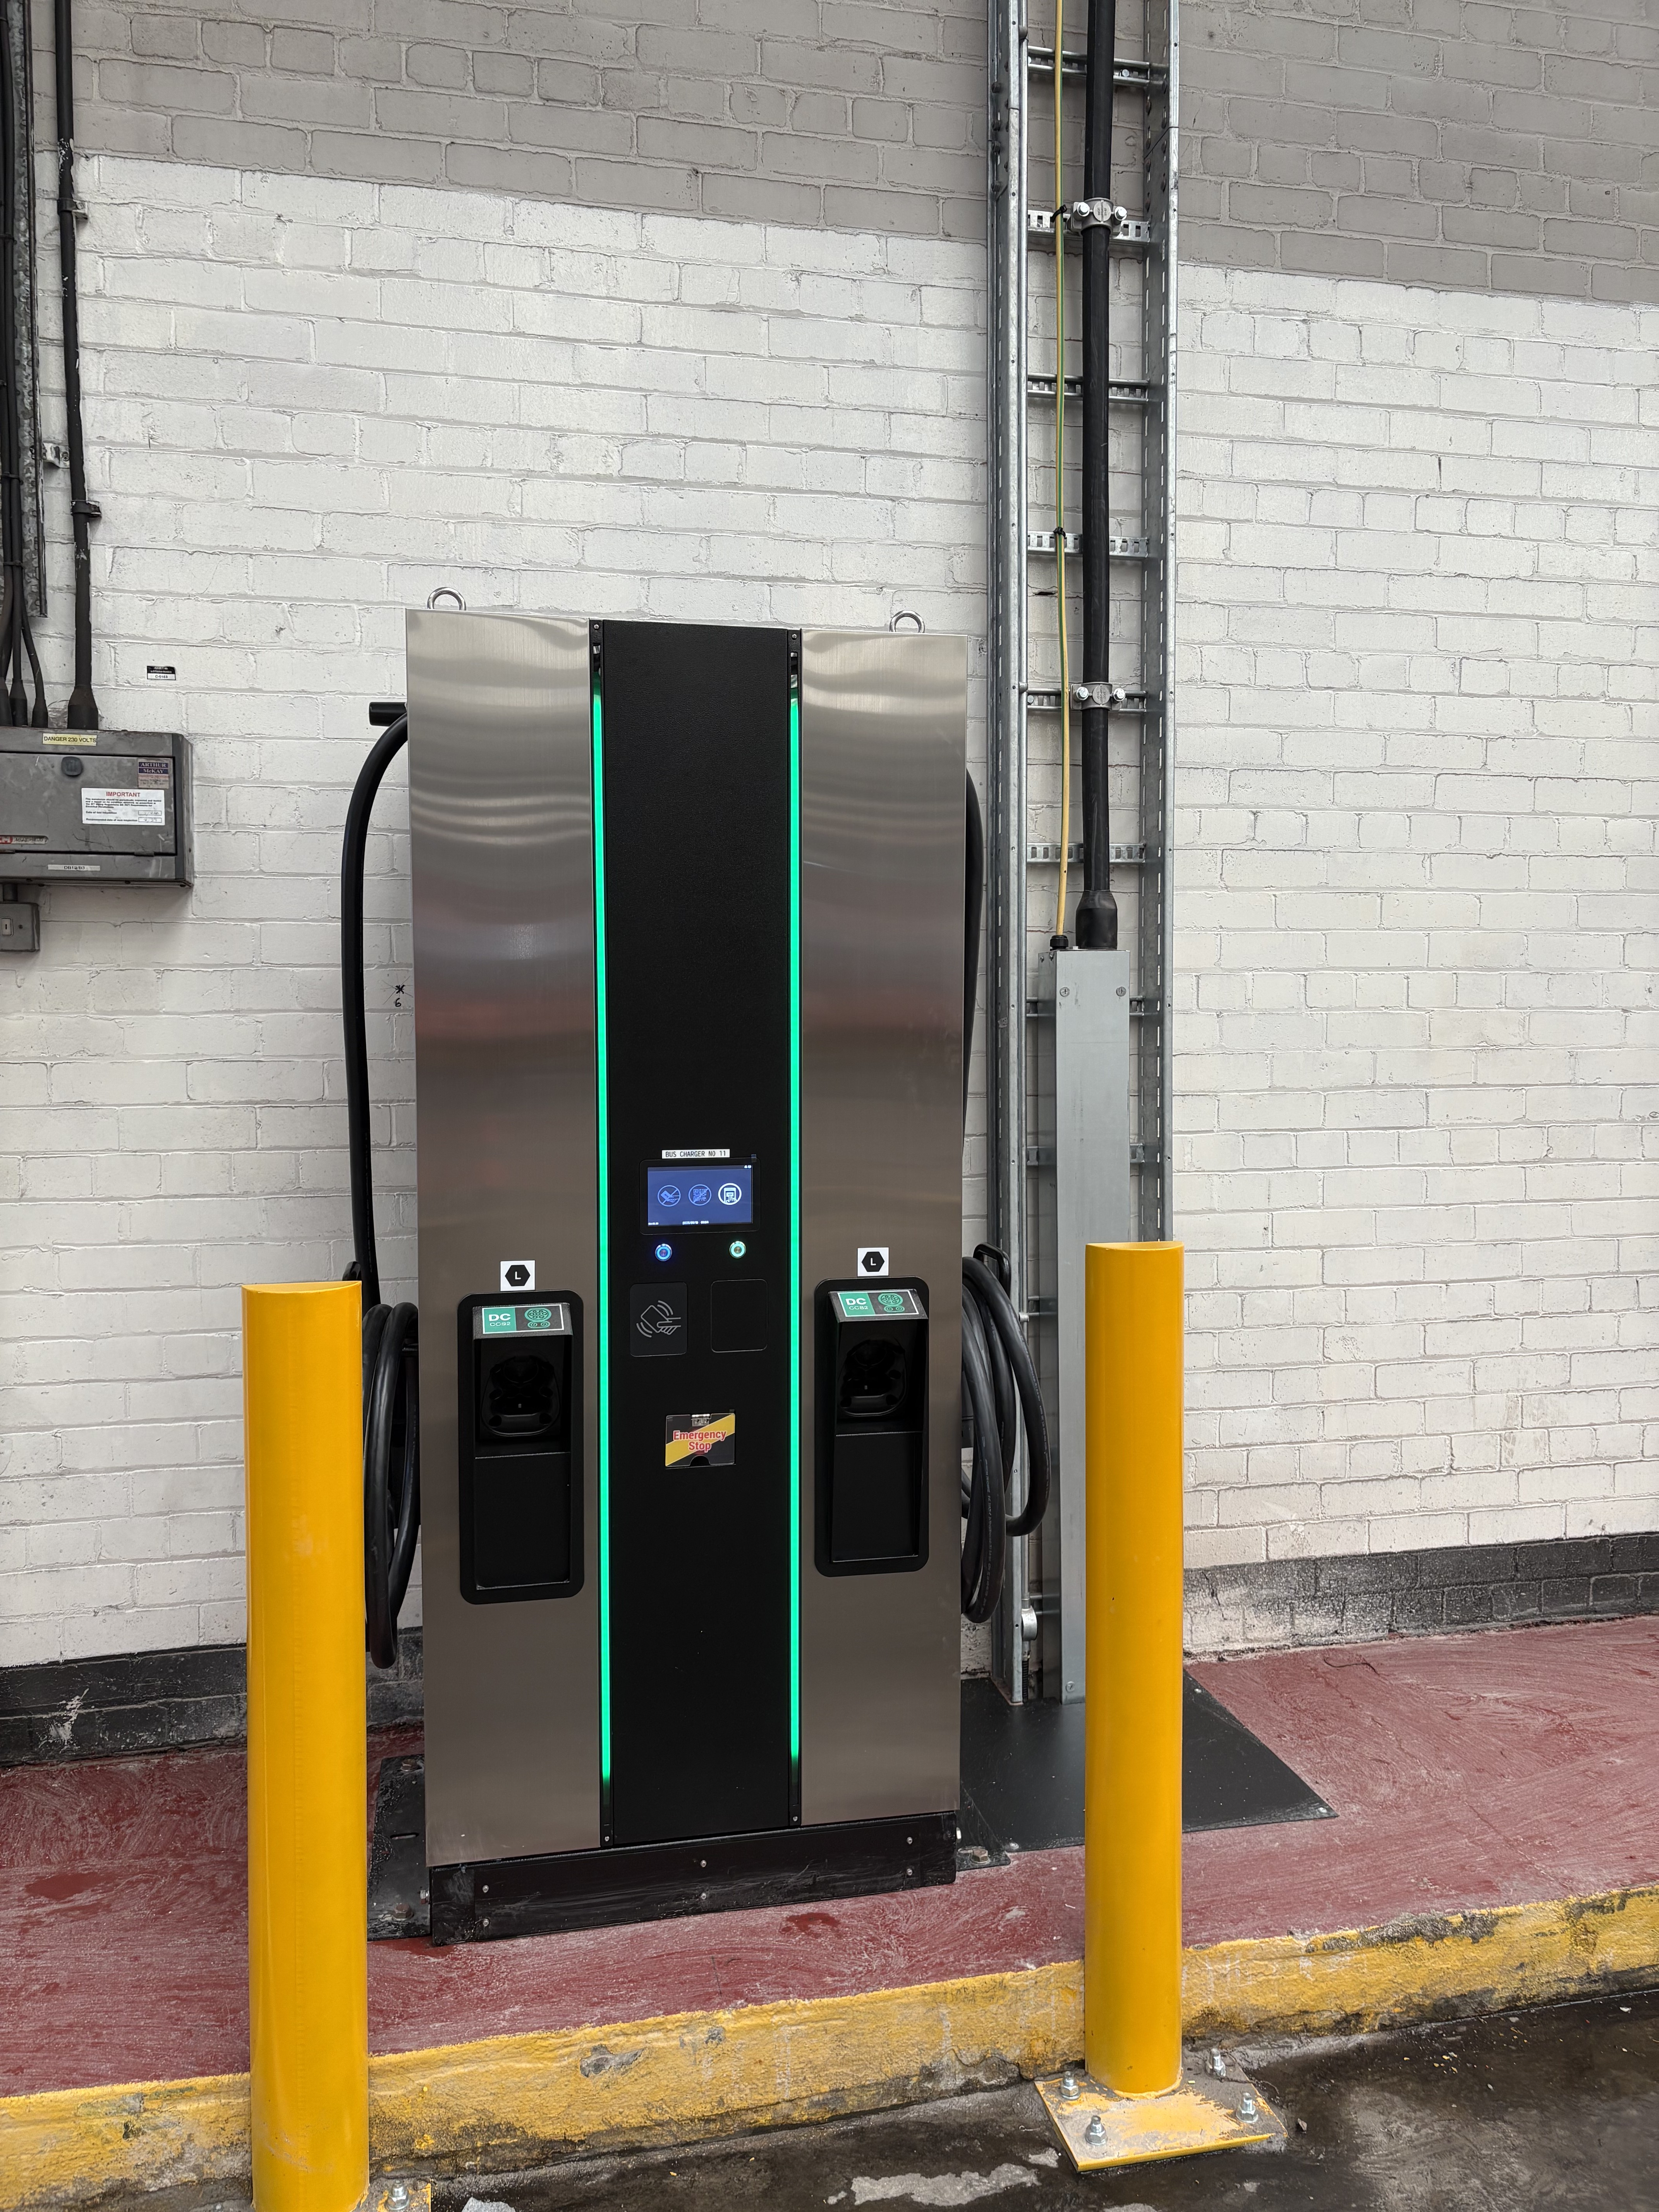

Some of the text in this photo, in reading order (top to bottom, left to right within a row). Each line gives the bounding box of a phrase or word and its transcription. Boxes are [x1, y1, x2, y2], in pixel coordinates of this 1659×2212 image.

[395, 998, 401, 1007] 6
[515, 1271, 521, 1279] L
[489, 1313, 511, 1321] DC
[673, 1431, 726, 1441] Emergency
[689, 1441, 712, 1453] Stop
